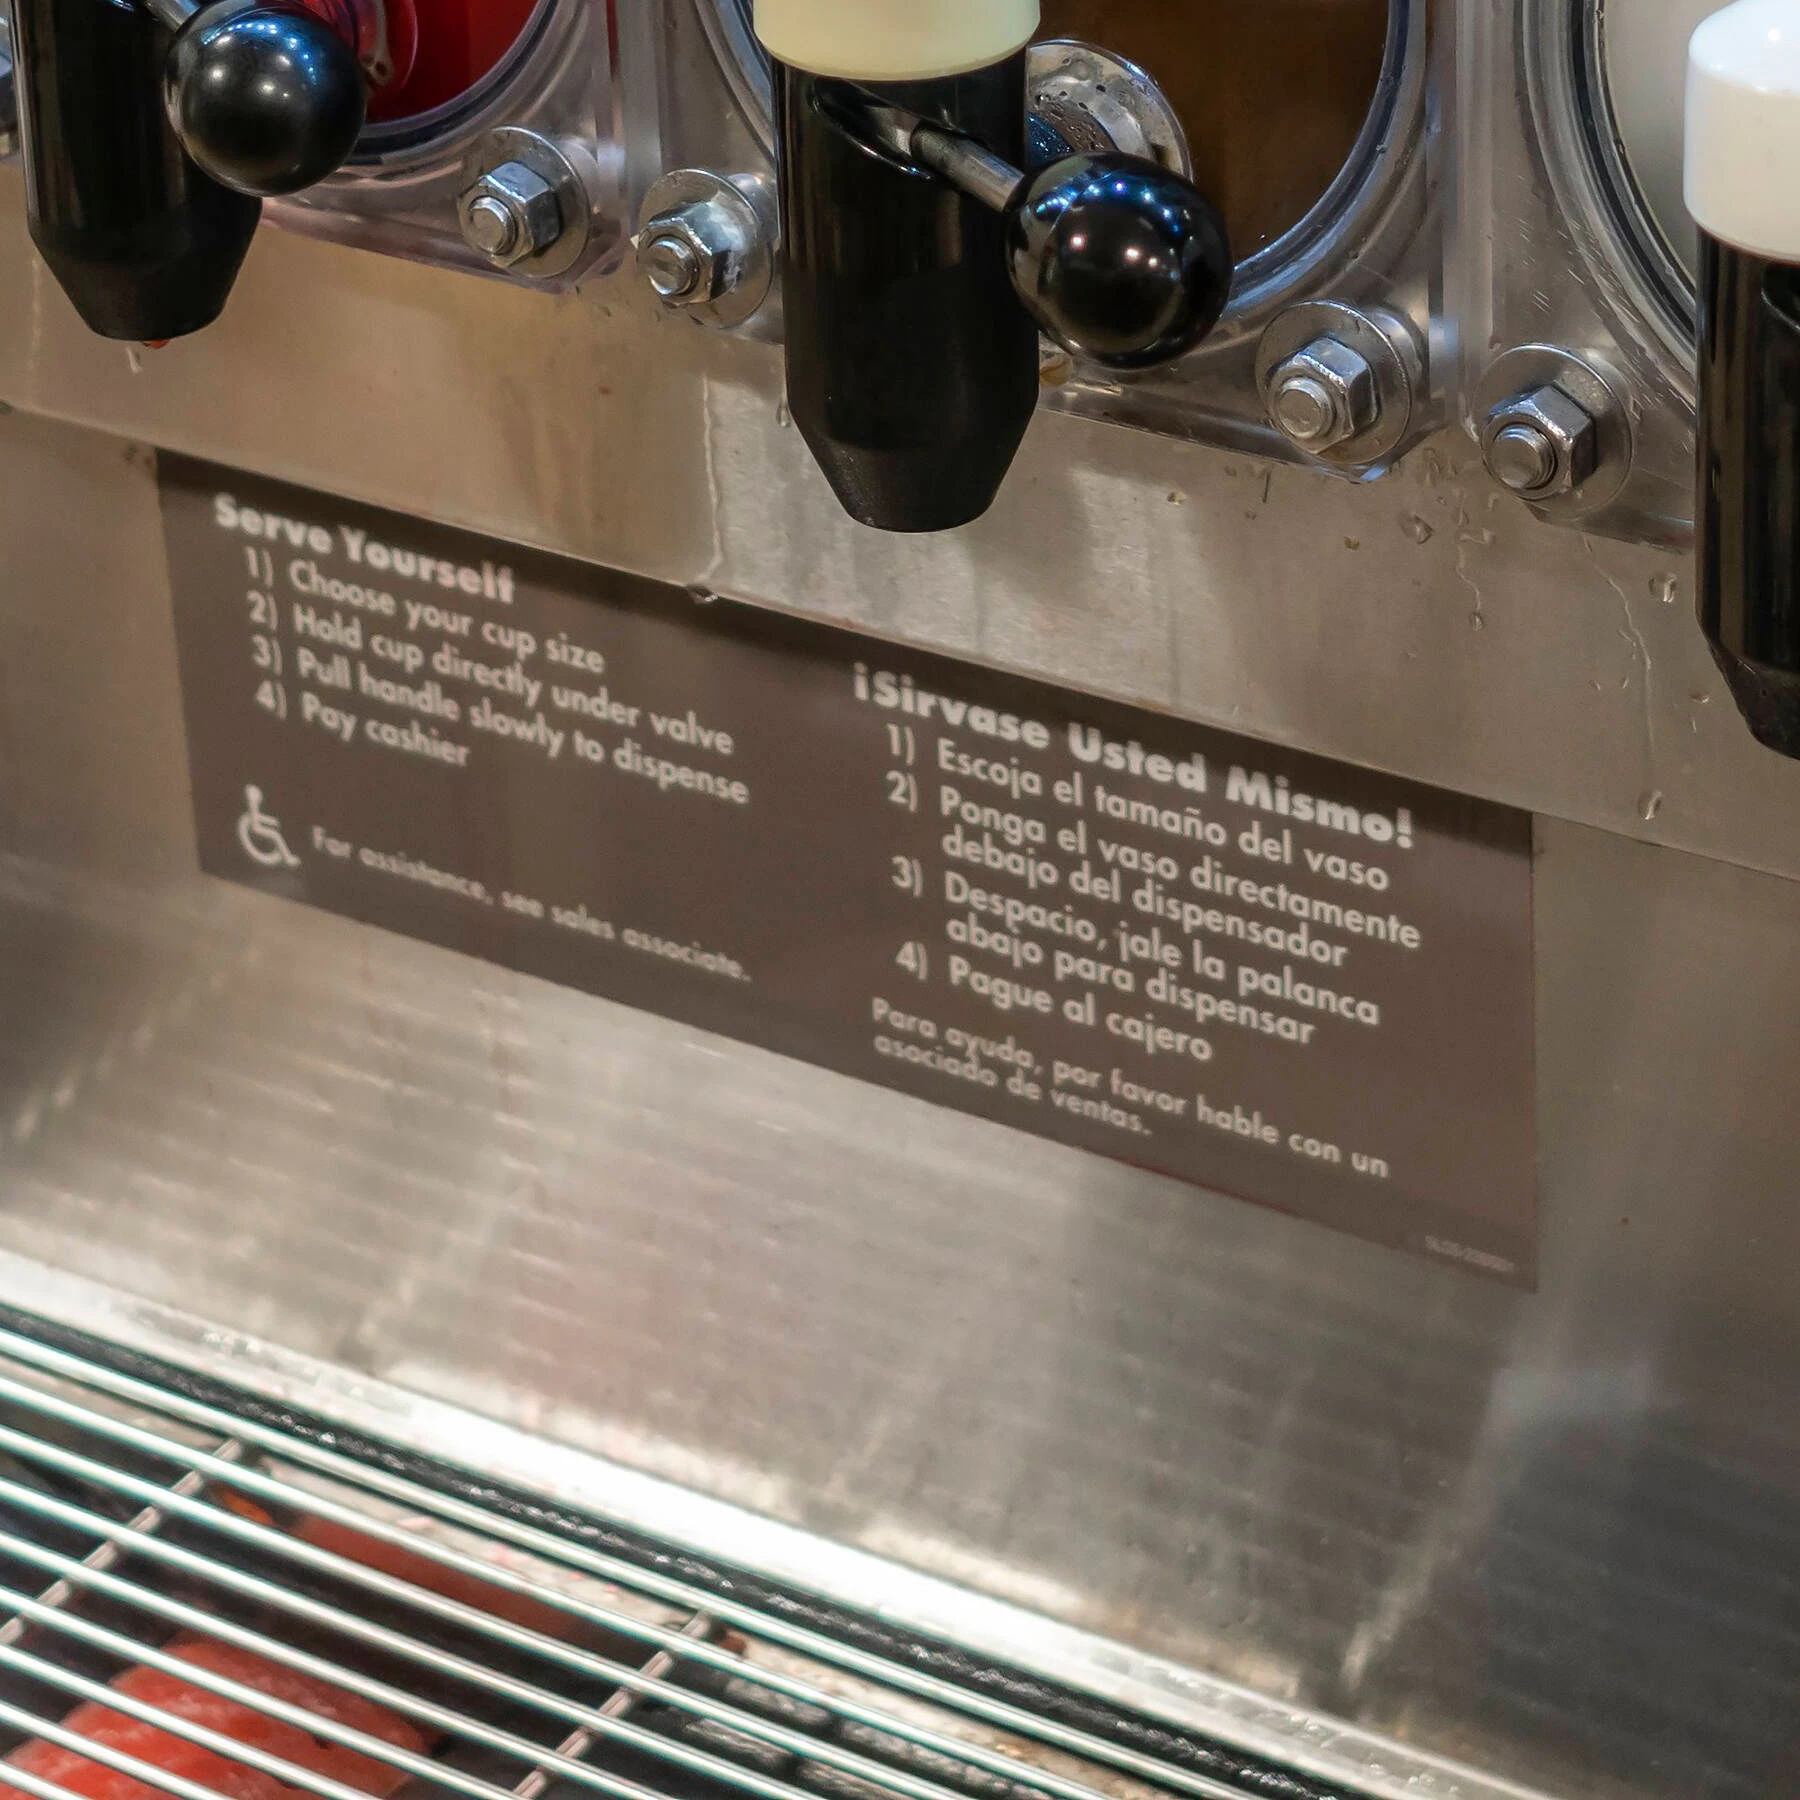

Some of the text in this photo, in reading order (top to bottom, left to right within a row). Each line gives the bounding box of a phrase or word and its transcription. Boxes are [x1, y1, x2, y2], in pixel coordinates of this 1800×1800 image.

[215, 493, 514, 604] Serve Yourself
[247, 546, 605, 673] 1) Choose your cup size
[248, 591, 734, 756] 2) Hold cup directly under valve
[251, 636, 750, 805] 3) Pull handle slowly to dispense
[256, 681, 471, 768] 4) Pay cashier
[854, 662, 1413, 849] ¡Sirvase Usted Mismo!
[886, 723, 1389, 892] 1) Escoja el tamaño del vaso
[312, 825, 751, 983] For assistance, see sales associate.
[886, 771, 1421, 950] 2) Ponga el vaso directamente
[942, 830, 1349, 969] debajo del dispensador
[892, 855, 1380, 1027] 3) Despacio, jale la palanca
[896, 940, 1212, 1063] 4) Pague al cajero
[947, 913, 1315, 1046] abajo para dispensar
[872, 997, 1390, 1179] Para ayuda, por favor hable con un
[873, 1031, 1153, 1136] asociado de ventas.
